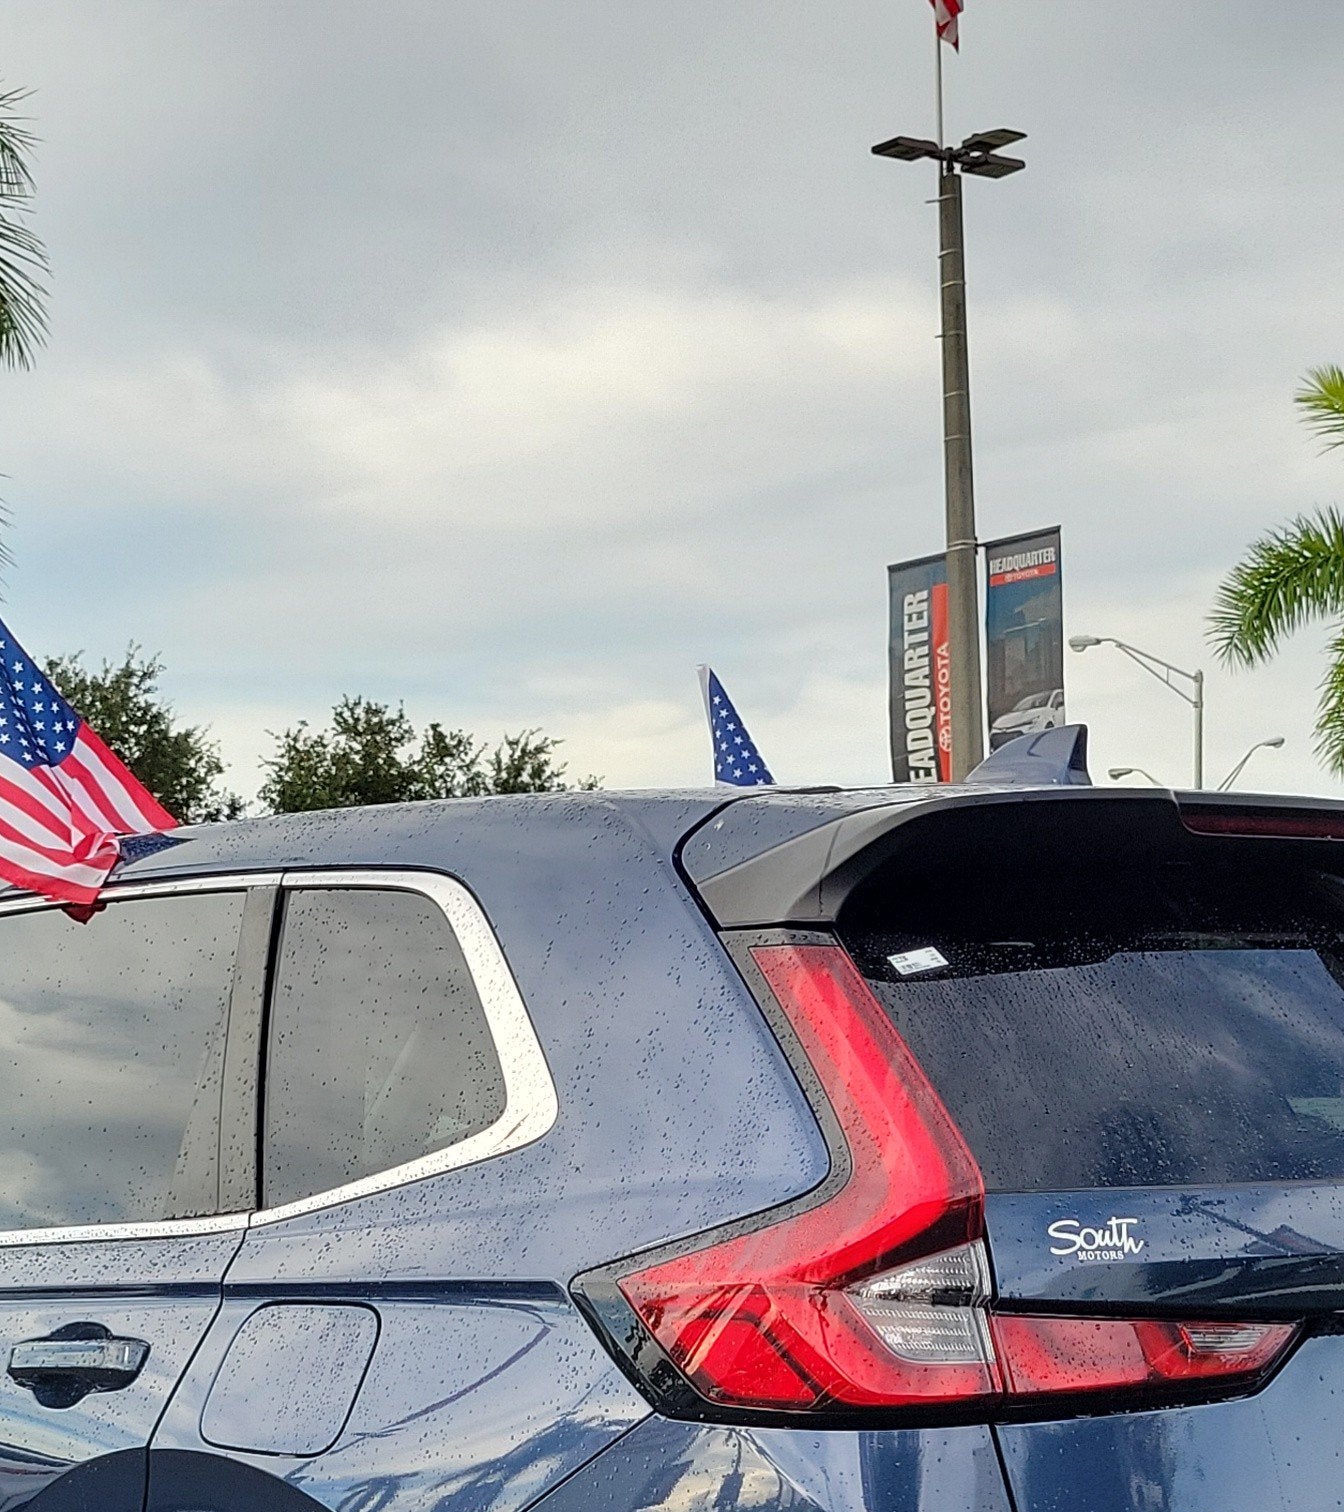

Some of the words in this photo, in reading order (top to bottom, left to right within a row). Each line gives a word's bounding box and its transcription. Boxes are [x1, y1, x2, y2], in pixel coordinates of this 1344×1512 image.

[989, 547, 1055, 575] HEADQUARTER
[904, 589, 938, 783] EADQUARTER
[936, 642, 951, 725] TOYOTA
[1047, 1216, 1144, 1255] South
[1077, 1250, 1124, 1261] MOTORS
